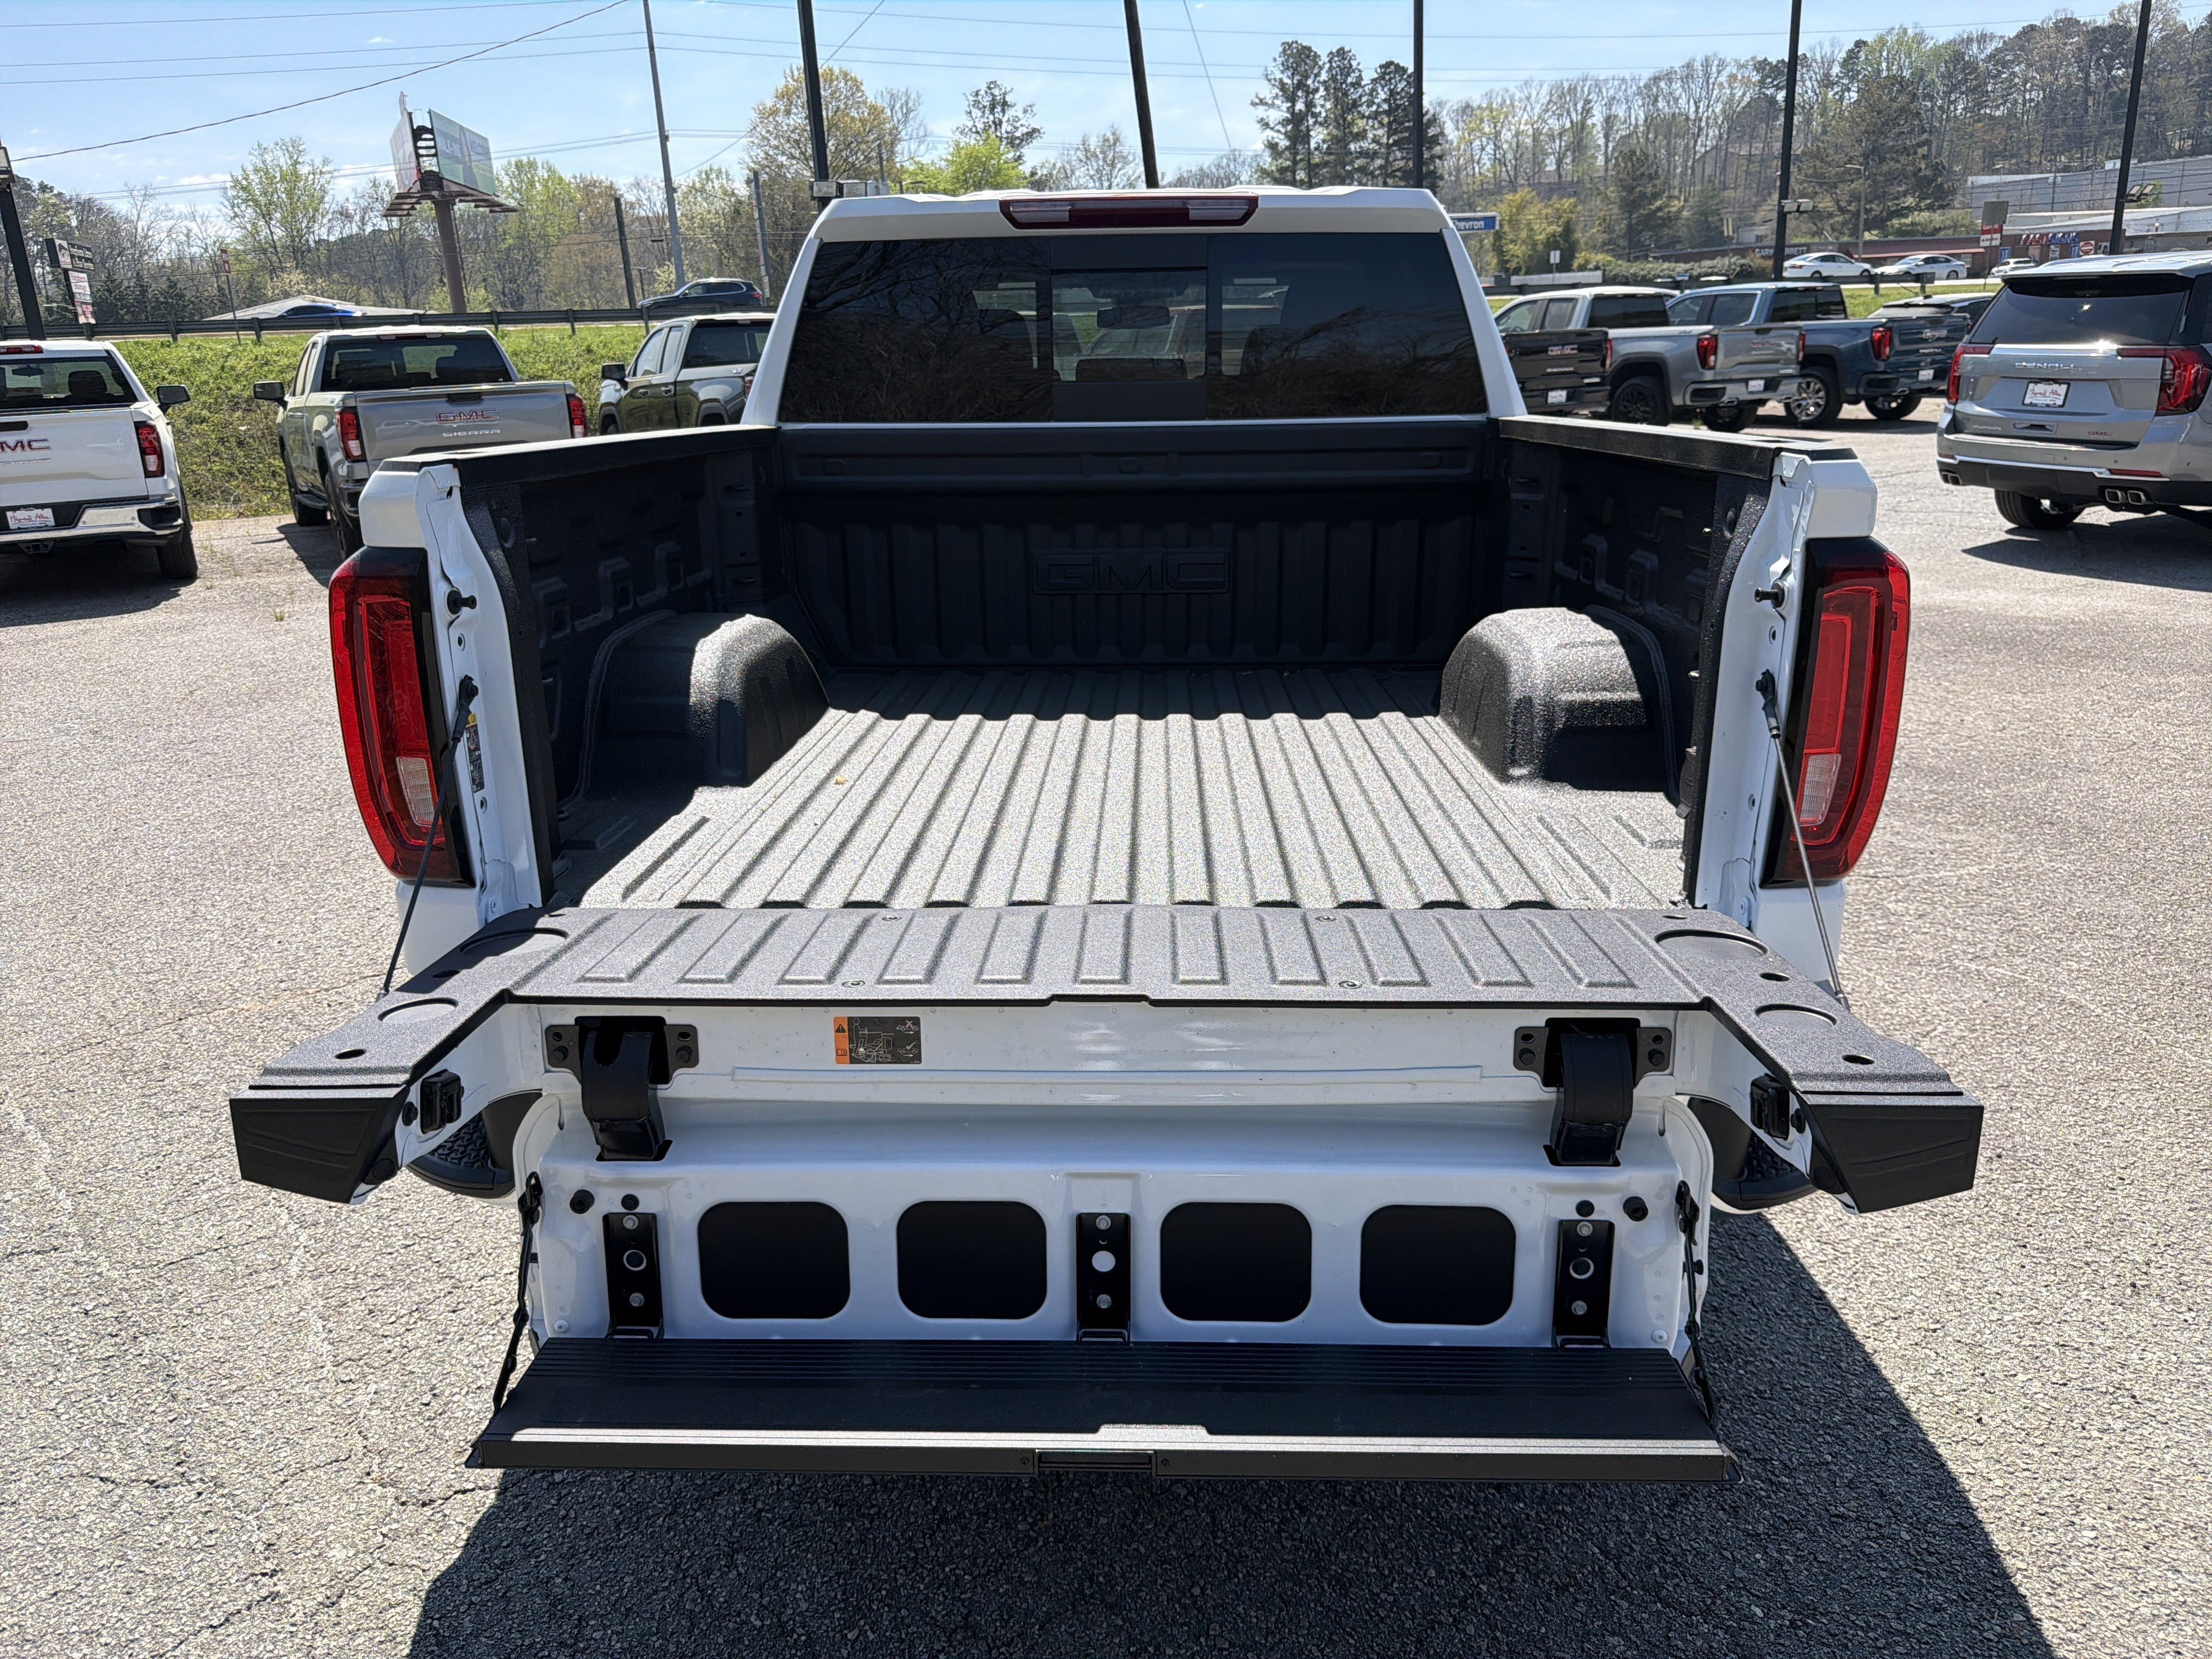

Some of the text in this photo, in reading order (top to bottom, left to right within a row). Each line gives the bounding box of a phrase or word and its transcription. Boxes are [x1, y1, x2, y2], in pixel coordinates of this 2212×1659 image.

[437, 408, 500, 424] GMC
[442, 429, 501, 437] SIERRA
[0, 439, 52, 454] MC
[1036, 552, 1227, 591] GMC
